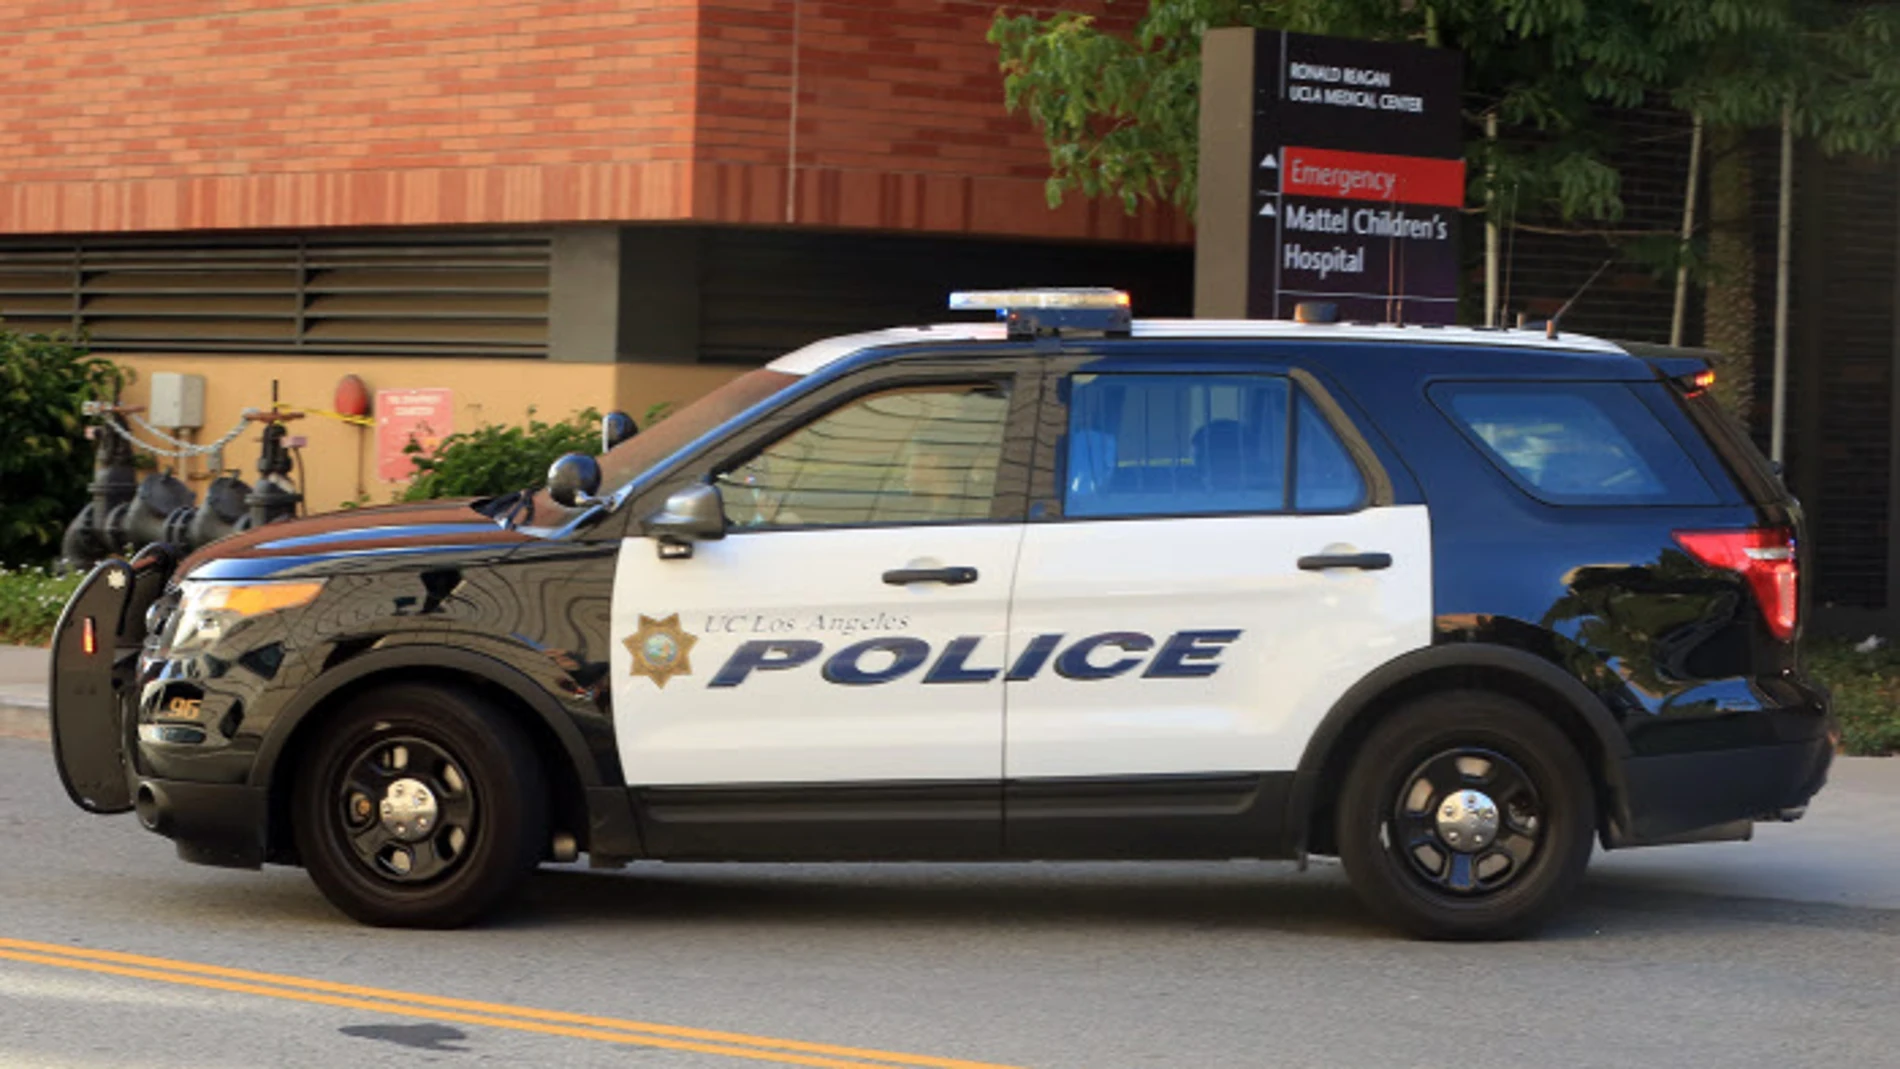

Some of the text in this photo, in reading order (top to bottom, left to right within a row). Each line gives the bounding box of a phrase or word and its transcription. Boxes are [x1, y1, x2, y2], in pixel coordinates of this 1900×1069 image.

[1290, 62, 1391, 88] RONALD REAGAN
[1289, 86, 1423, 112] UCLA MEDICAL CENTER
[1291, 159, 1396, 198] Emergency
[1285, 204, 1448, 240] Mattel Children's
[1284, 244, 1364, 279] Hospital
[705, 612, 911, 636] UC Los Angeles
[706, 628, 1244, 689] POLICE
